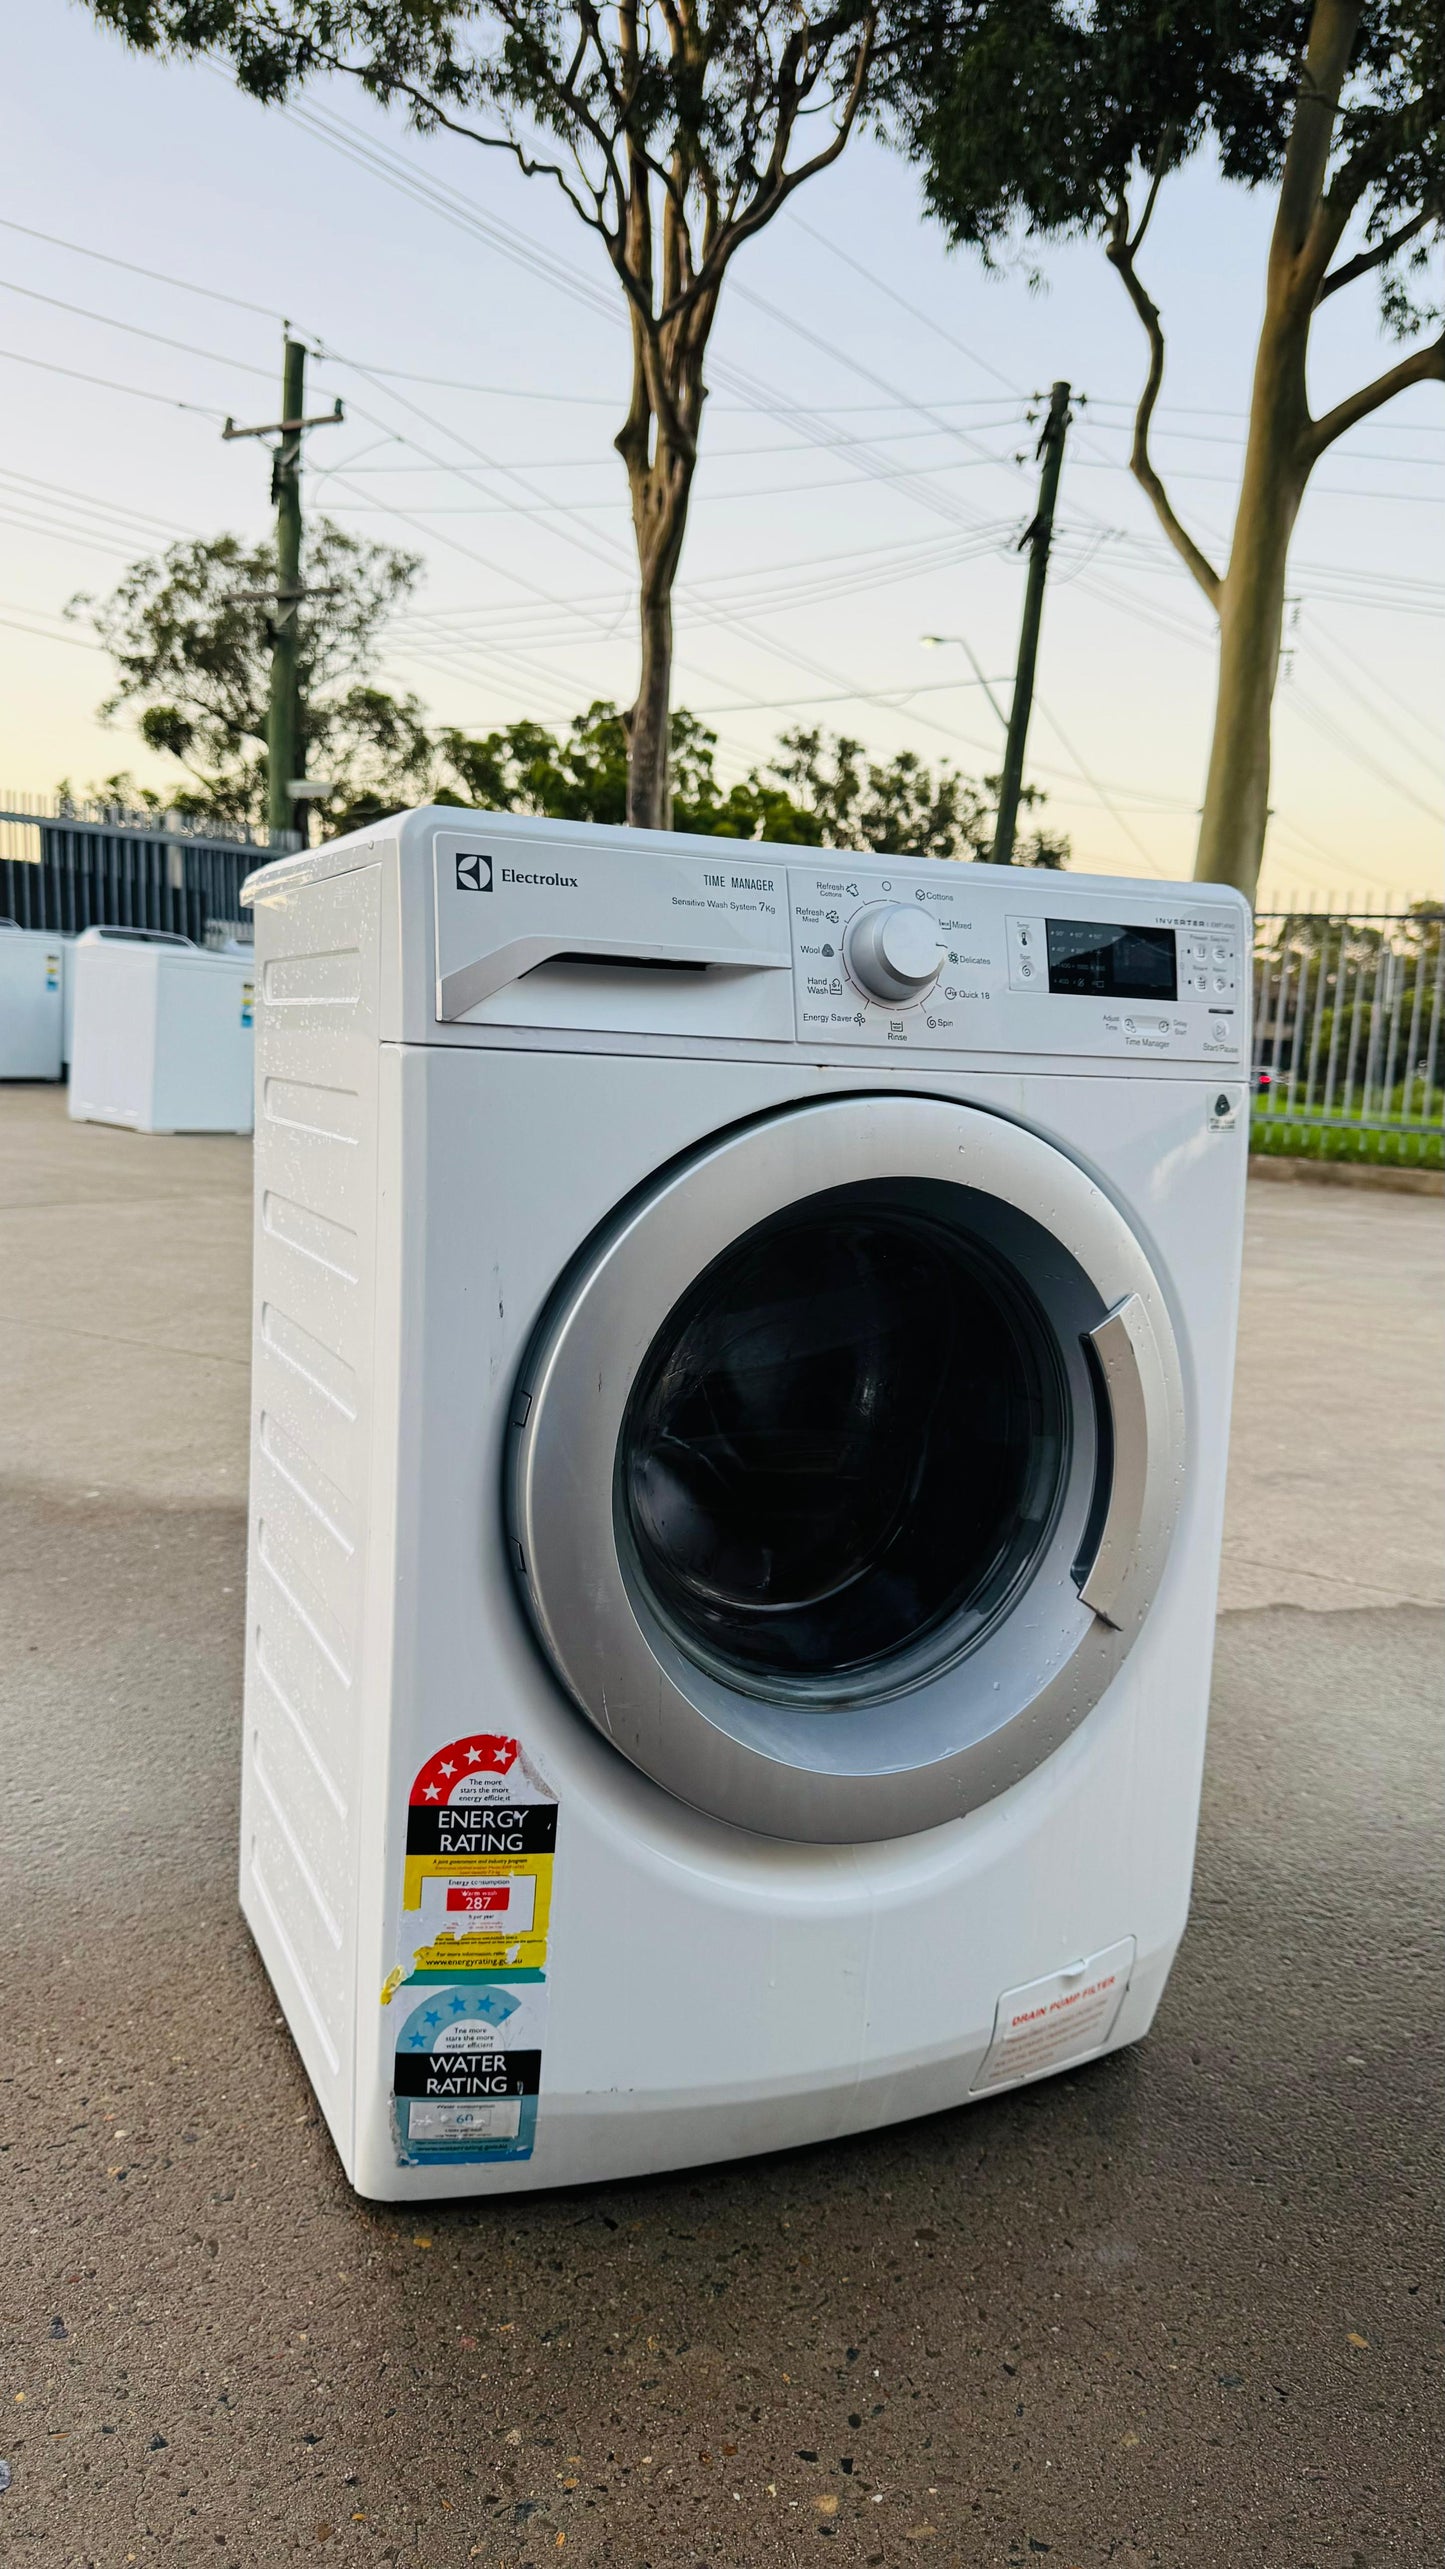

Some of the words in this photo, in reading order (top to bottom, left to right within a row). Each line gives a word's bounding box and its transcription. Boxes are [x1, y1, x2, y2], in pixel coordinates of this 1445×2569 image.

[501, 868, 578, 888] Electrolux
[704, 874, 725, 888] TIME
[731, 876, 774, 892] MANAGER
[816, 882, 844, 892] Refresh
[820, 890, 842, 898] Cottons
[926, 891, 954, 902] Cottons
[672, 896, 706, 908] Sensitive
[706, 900, 728, 910] Wash
[730, 901, 757, 912] System
[796, 907, 824, 918] Refresh
[952, 920, 972, 930] Mixed
[1156, 918, 1205, 927] INVERTER
[800, 945, 820, 954] Wool
[959, 955, 991, 966] Delicates
[807, 977, 828, 986] Hand
[806, 986, 828, 995] Wash
[959, 990, 979, 1000] Quick
[803, 1013, 830, 1024] Energy
[831, 1013, 852, 1022] Saver
[938, 1018, 954, 1028] Spin
[888, 1032, 908, 1042] Rinse
[1125, 1037, 1141, 1046] Time
[1142, 1038, 1170, 1048] Manager
[470, 1778, 483, 1786] The
[438, 1810, 530, 1828] ENERGY
[440, 1834, 524, 1852] RATING
[466, 1896, 492, 1910] 287
[1012, 2006, 1048, 2027] DRAIN
[1049, 1993, 1081, 2013] PUMP
[1082, 1976, 1116, 2000] FILTER
[429, 2054, 507, 2073] WATER
[426, 2076, 508, 2094] RATING
